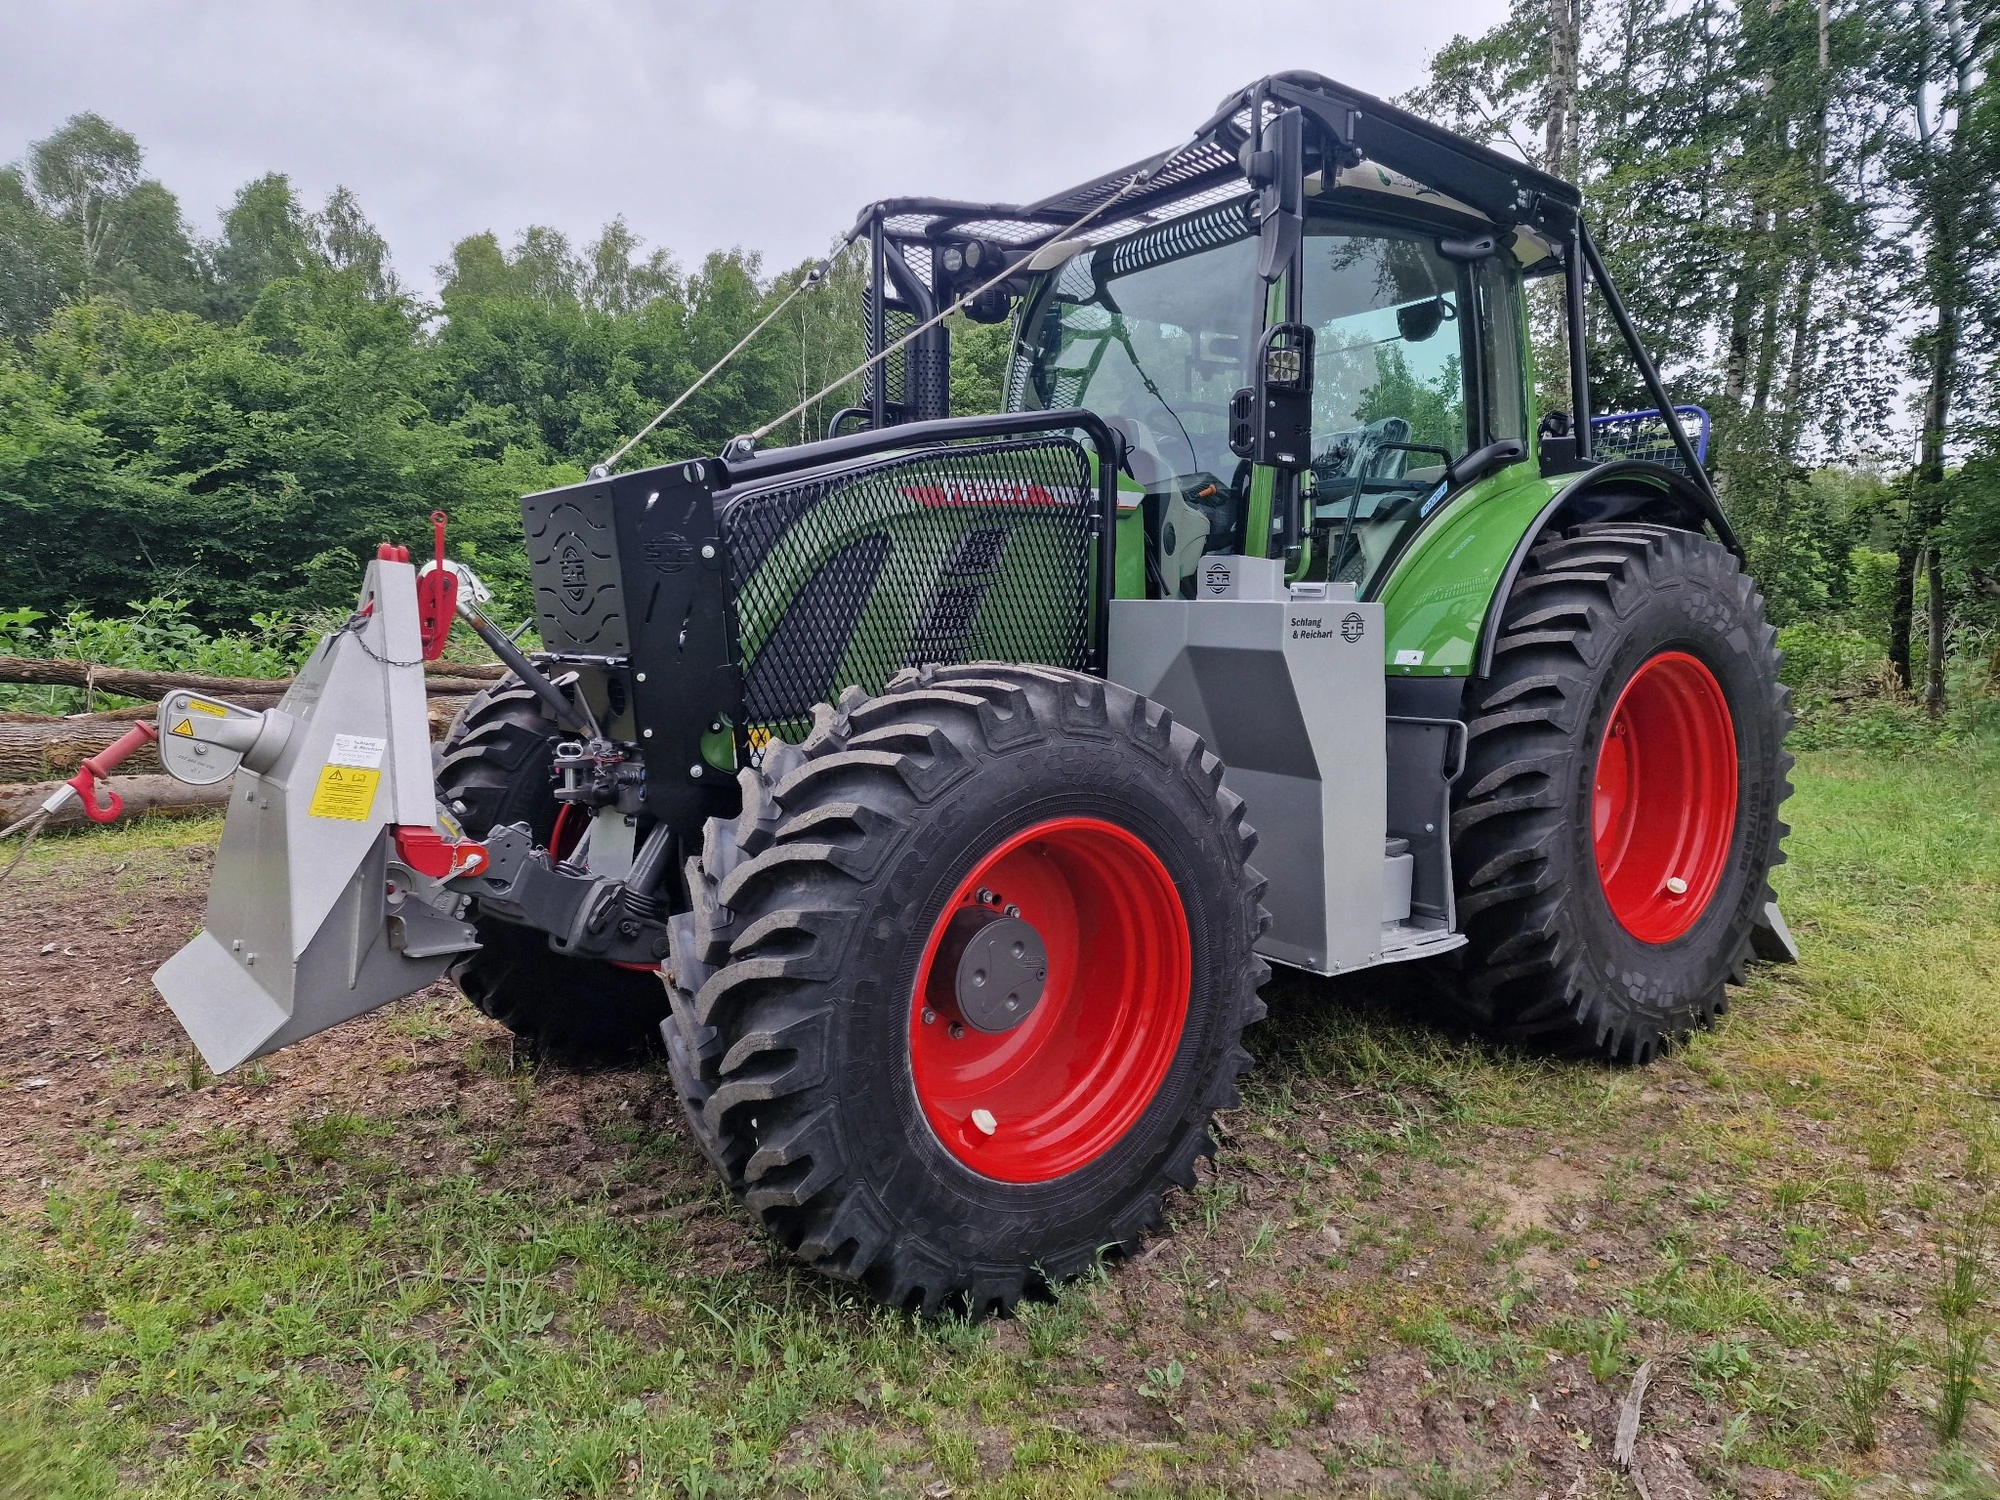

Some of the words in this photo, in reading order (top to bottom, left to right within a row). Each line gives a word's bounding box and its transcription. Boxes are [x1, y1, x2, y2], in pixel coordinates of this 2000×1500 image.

[1290, 617, 1323, 629] Schlang
[1292, 629, 1299, 640] &
[1300, 629, 1333, 640] Reichart
[857, 800, 967, 964] TYRES
